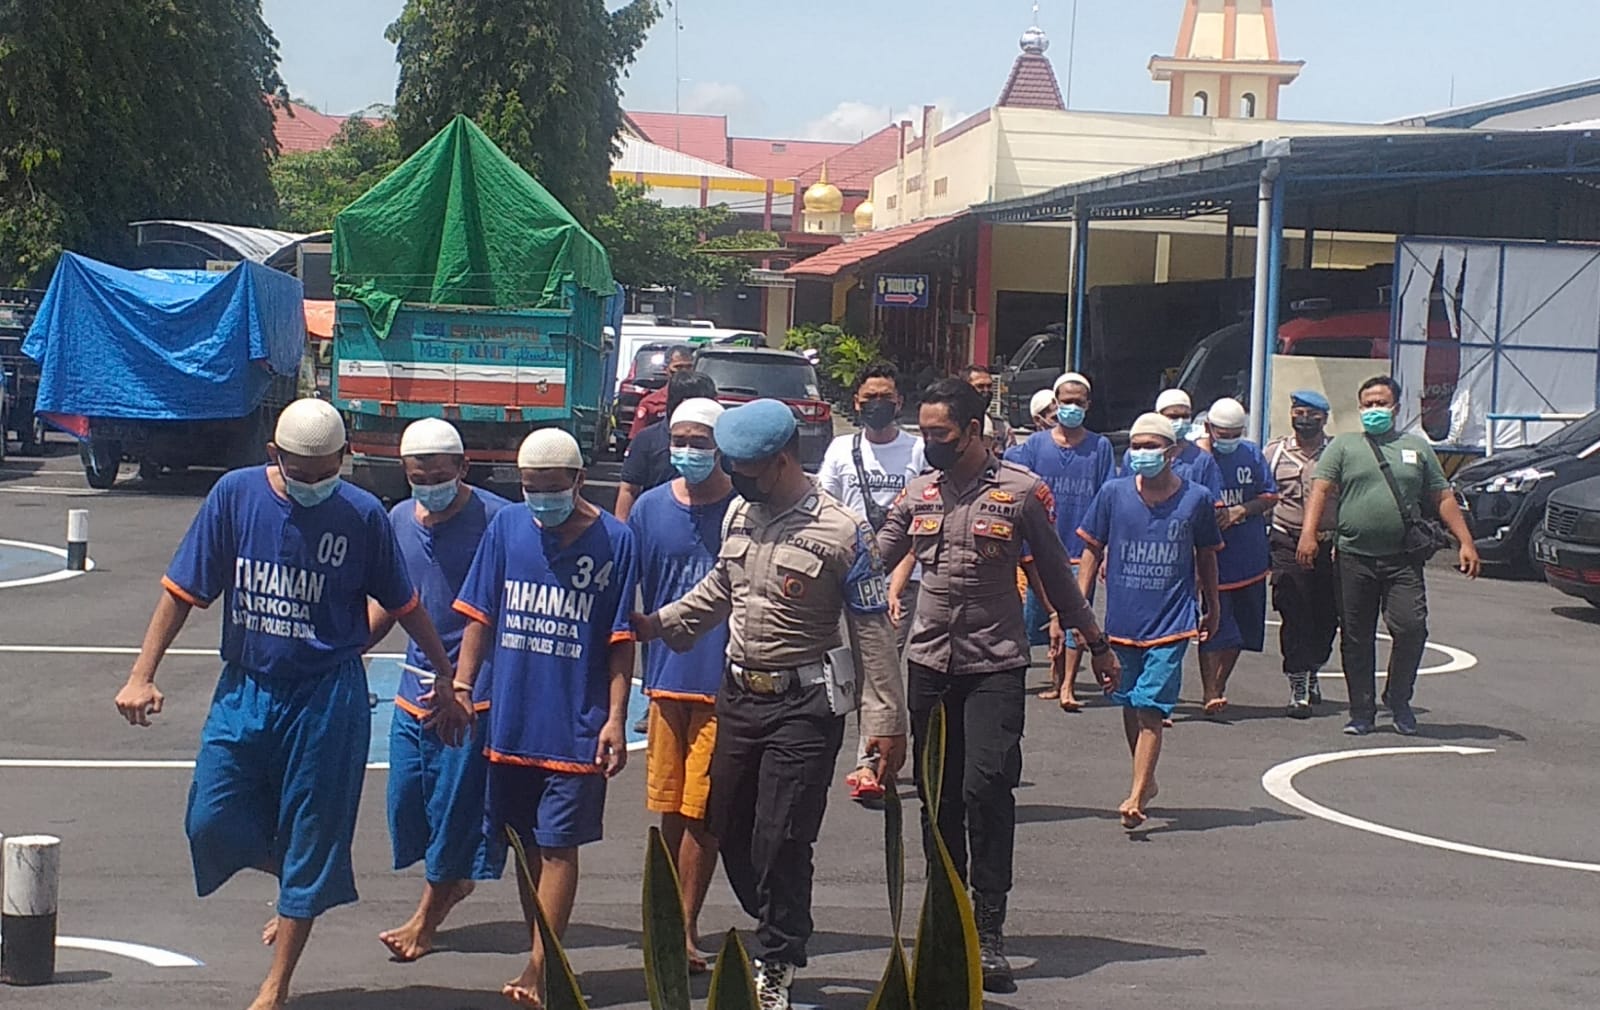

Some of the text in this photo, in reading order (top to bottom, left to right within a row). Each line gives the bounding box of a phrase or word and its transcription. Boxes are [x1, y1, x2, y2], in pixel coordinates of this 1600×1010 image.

[1236, 466, 1253, 484] 02
[980, 503, 1016, 516] POLRI
[317, 532, 347, 567] 09
[785, 534, 827, 556] POLRI
[1120, 539, 1180, 565] TAHANA
[235, 557, 325, 604] TAHANAN
[571, 555, 613, 592] 34
[1122, 563, 1173, 577] NARKOB
[505, 580, 595, 623] TAHANAN
[260, 616, 292, 638] POLRES
[506, 614, 579, 639] NARKOBA
